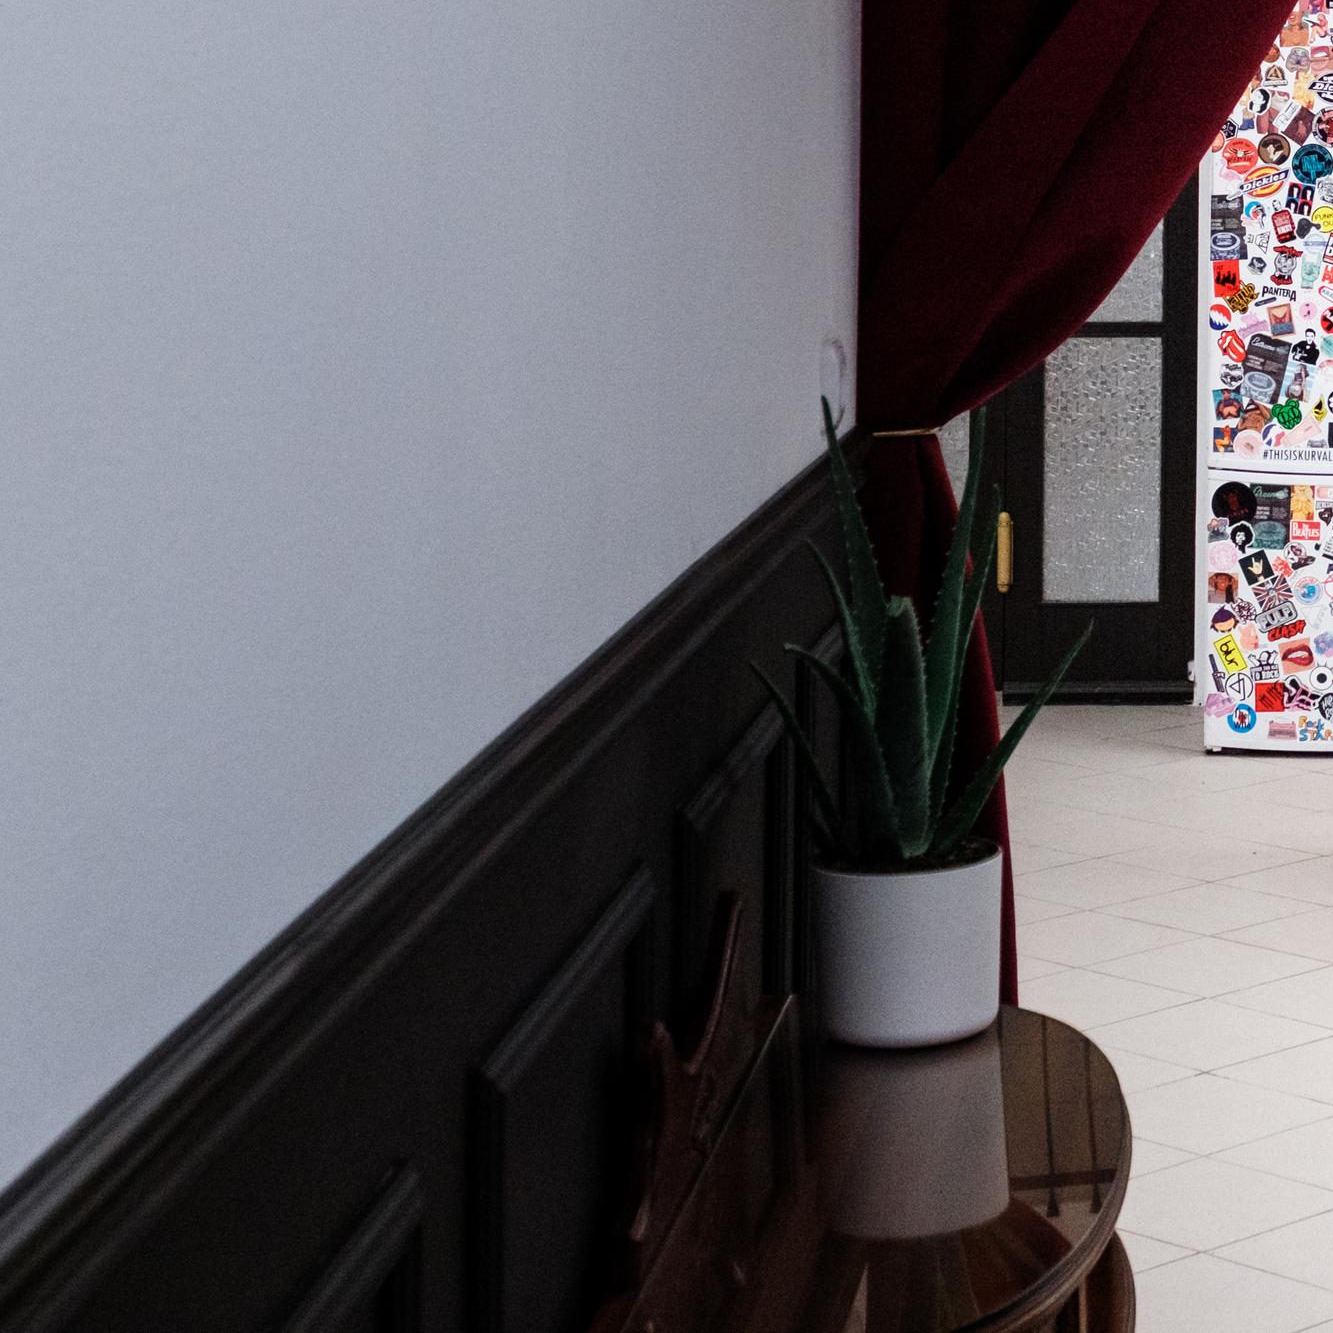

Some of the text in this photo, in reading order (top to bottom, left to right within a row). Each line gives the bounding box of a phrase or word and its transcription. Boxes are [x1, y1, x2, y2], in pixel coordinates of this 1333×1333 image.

[1242, 171, 1286, 192] Dickies
[1262, 286, 1297, 302] PANTERA
[1261, 606, 1294, 629] PULP
[1267, 619, 1306, 643] CLASH
[1220, 640, 1239, 667] blur
